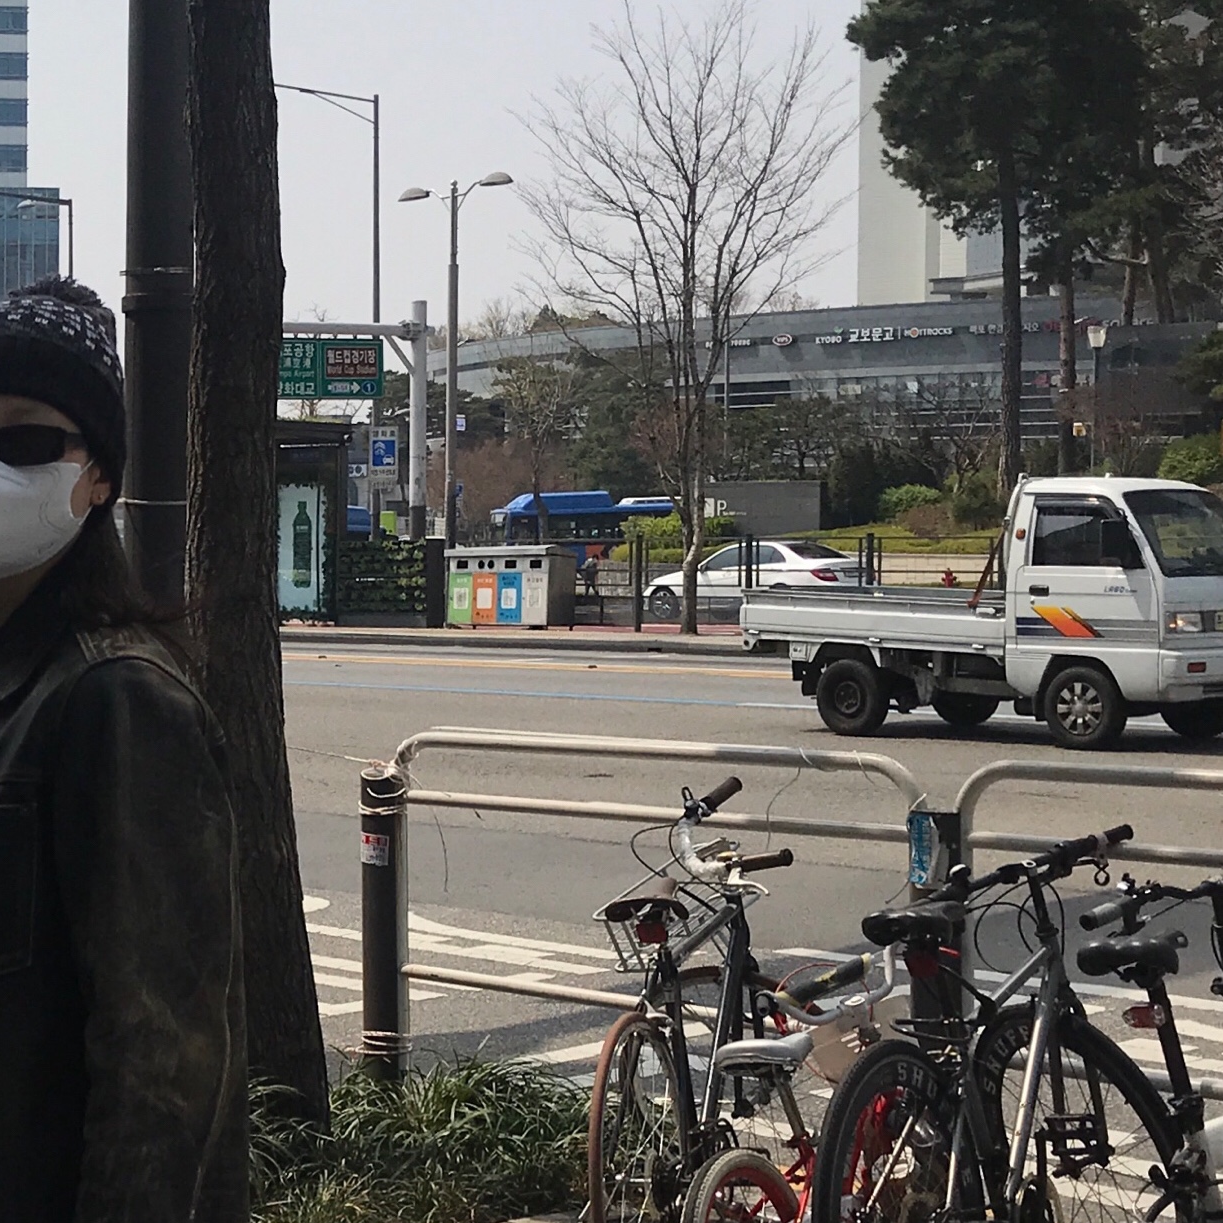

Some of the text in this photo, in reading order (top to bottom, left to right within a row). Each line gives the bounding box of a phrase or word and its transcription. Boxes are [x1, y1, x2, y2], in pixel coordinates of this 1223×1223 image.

[815, 335, 843, 345] KYOBO
[848, 328, 895, 343] 교보문고
[280, 343, 315, 358] 포공항
[326, 349, 376, 364] 월드컵경기장
[717, 499, 728, 516] P
